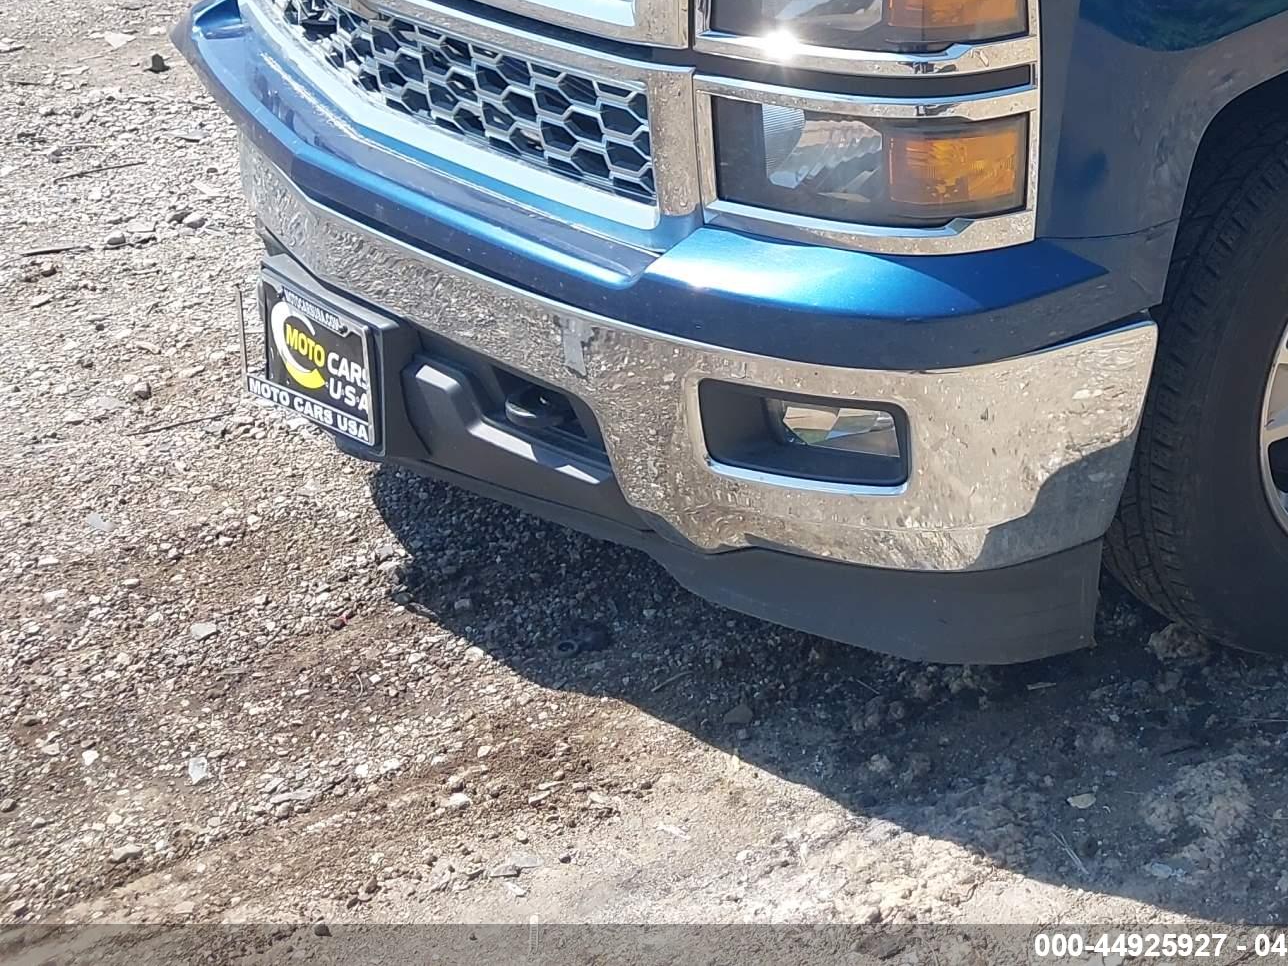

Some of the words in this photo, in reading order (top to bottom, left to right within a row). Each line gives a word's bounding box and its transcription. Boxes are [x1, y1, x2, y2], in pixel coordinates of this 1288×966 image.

[285, 324, 326, 367] MOTO
[327, 352, 369, 389] CARS
[249, 377, 290, 406] MOTO
[293, 396, 334, 425] CARS
[337, 414, 368, 441] USA
